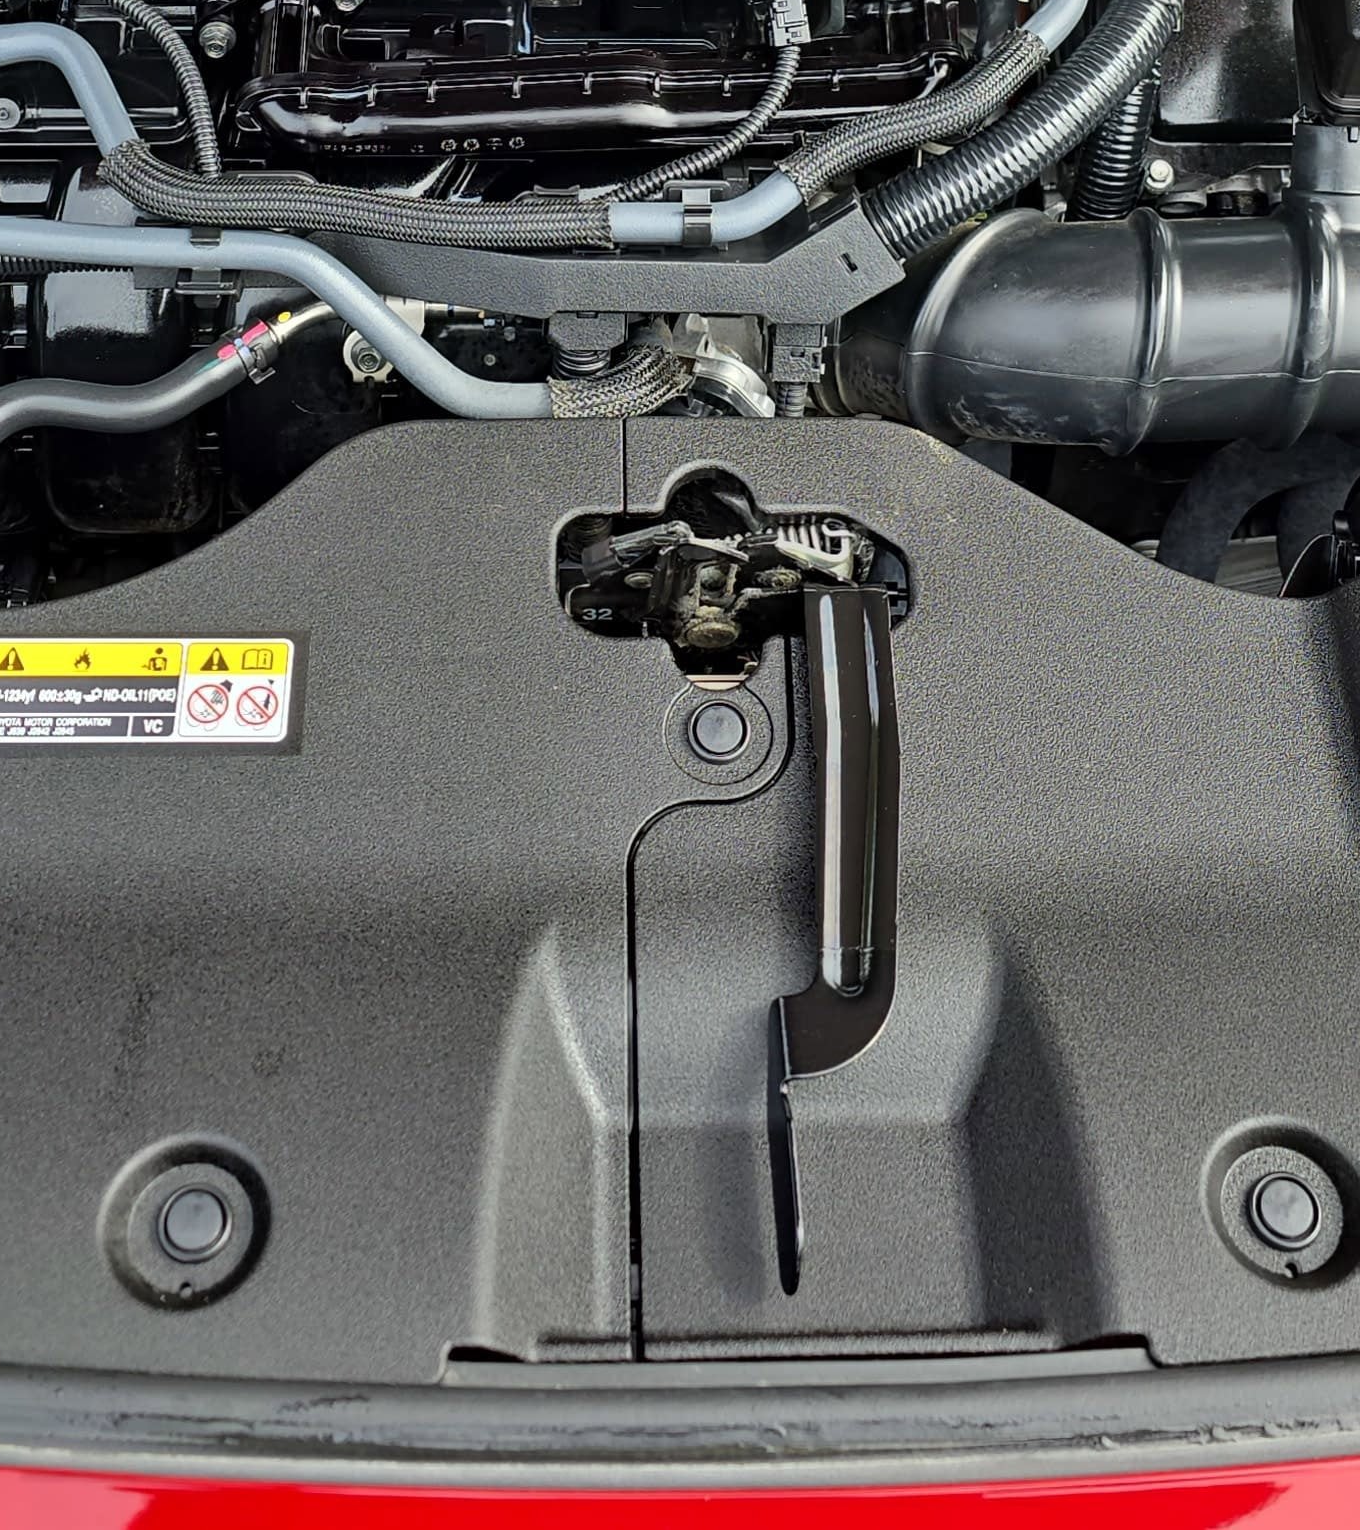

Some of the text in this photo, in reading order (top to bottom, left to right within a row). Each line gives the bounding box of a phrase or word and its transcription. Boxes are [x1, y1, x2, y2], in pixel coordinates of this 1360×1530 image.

[582, 608, 613, 620] 32
[24, 718, 53, 727] MOTOR
[56, 718, 112, 727] CORPORATION
[143, 719, 163, 734] VC
